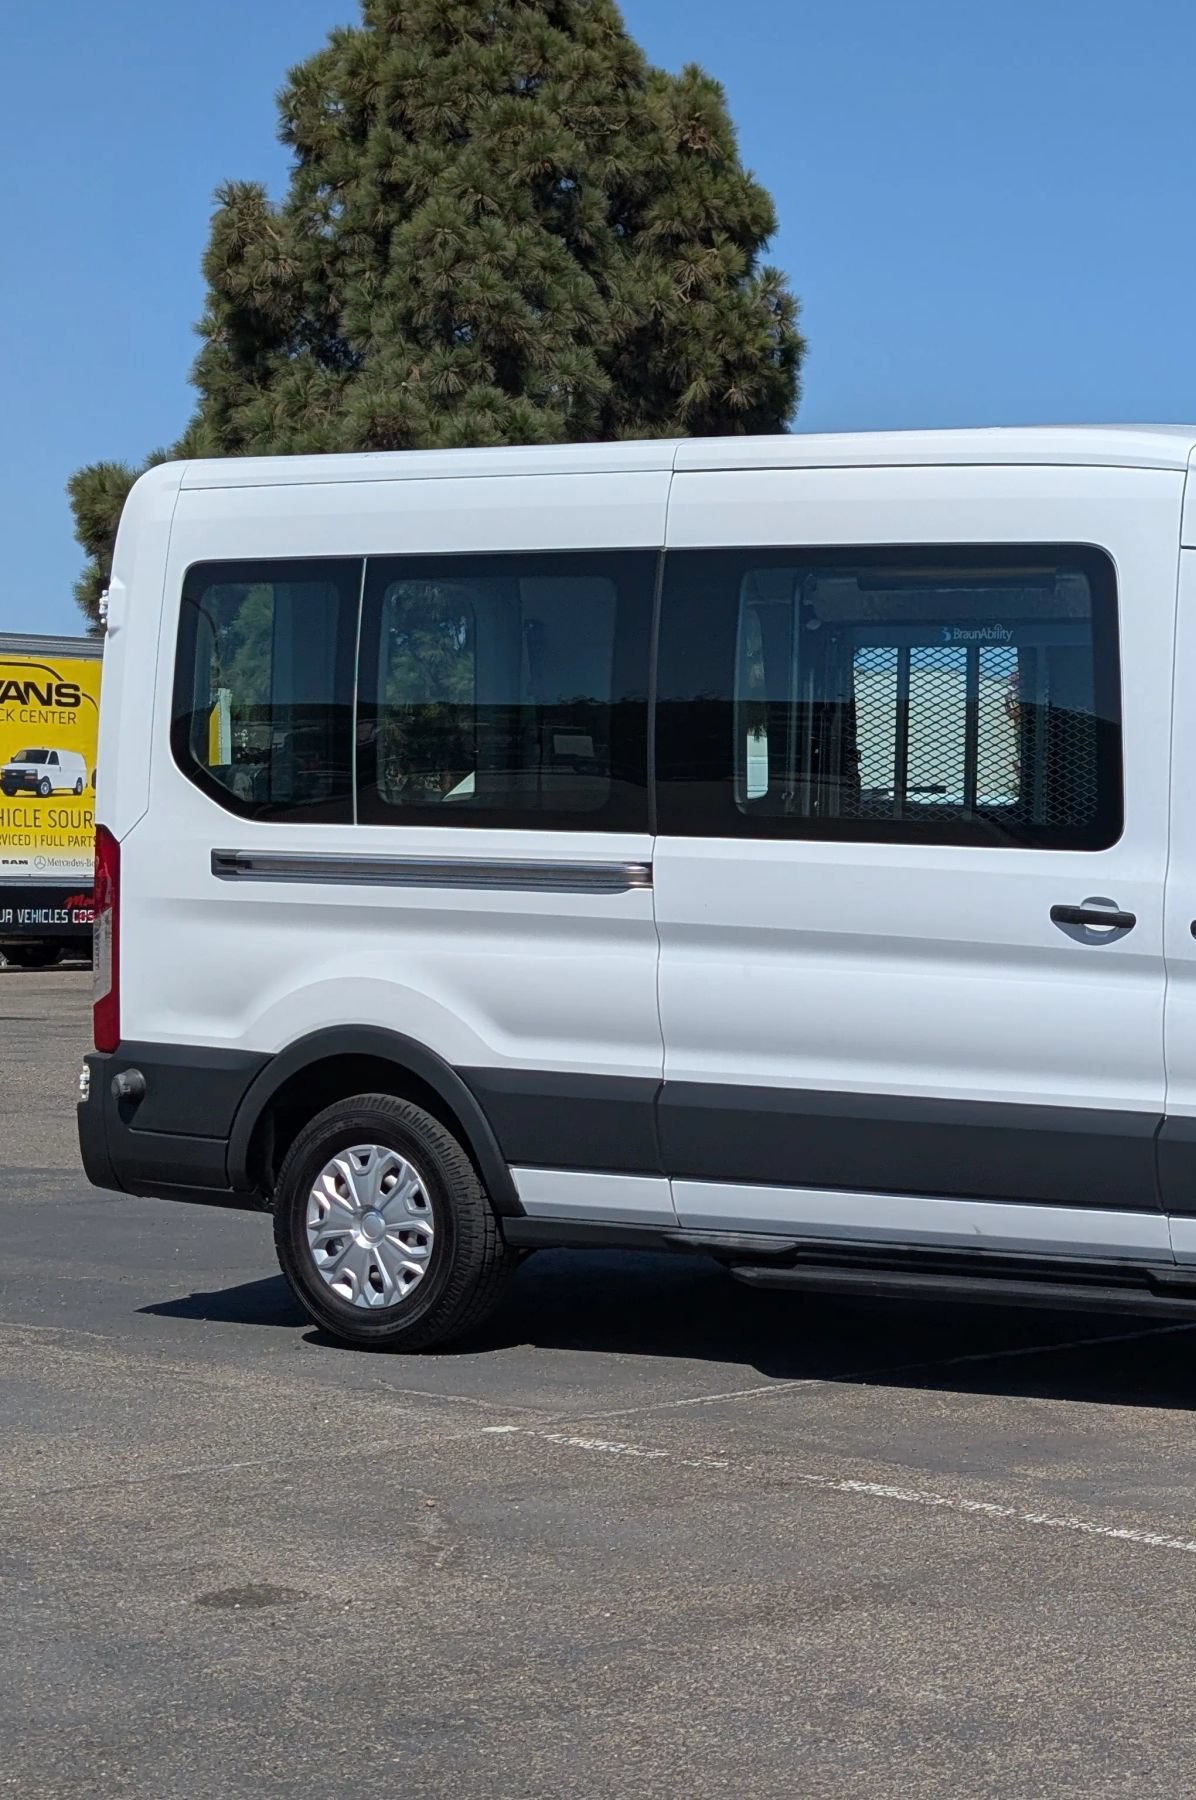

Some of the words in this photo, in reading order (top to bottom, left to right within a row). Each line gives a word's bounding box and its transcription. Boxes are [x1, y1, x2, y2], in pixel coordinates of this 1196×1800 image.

[953, 626, 1014, 642] BraunAbility
[0, 680, 81, 708] ANS
[20, 709, 77, 725] CENTER
[47, 809, 95, 829] SOUR
[0, 833, 31, 846] VICED
[40, 834, 65, 847] FULL
[17, 909, 69, 924] VEHICLES
